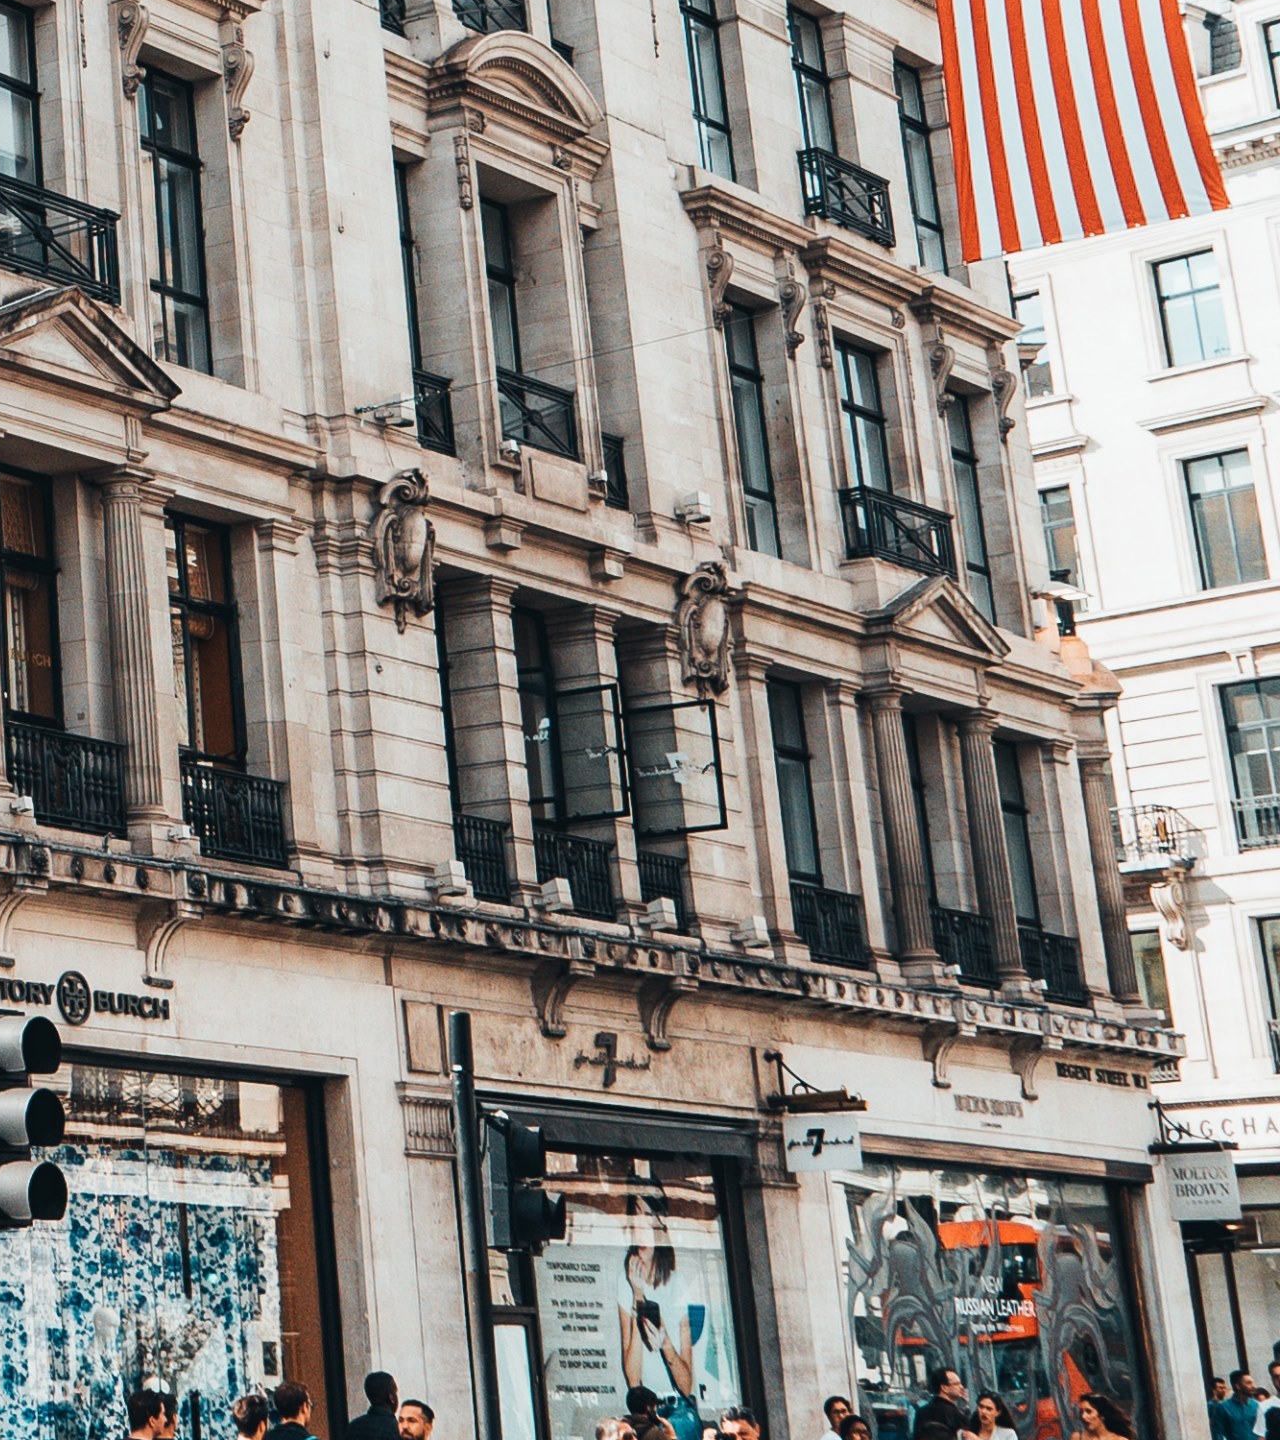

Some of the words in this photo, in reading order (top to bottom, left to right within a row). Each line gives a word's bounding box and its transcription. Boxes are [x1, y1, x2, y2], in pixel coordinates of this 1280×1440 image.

[93, 989, 171, 1020] BURCH
[1172, 1165, 1228, 1181] MOLTON
[1175, 1182, 1230, 1198] BROWN
